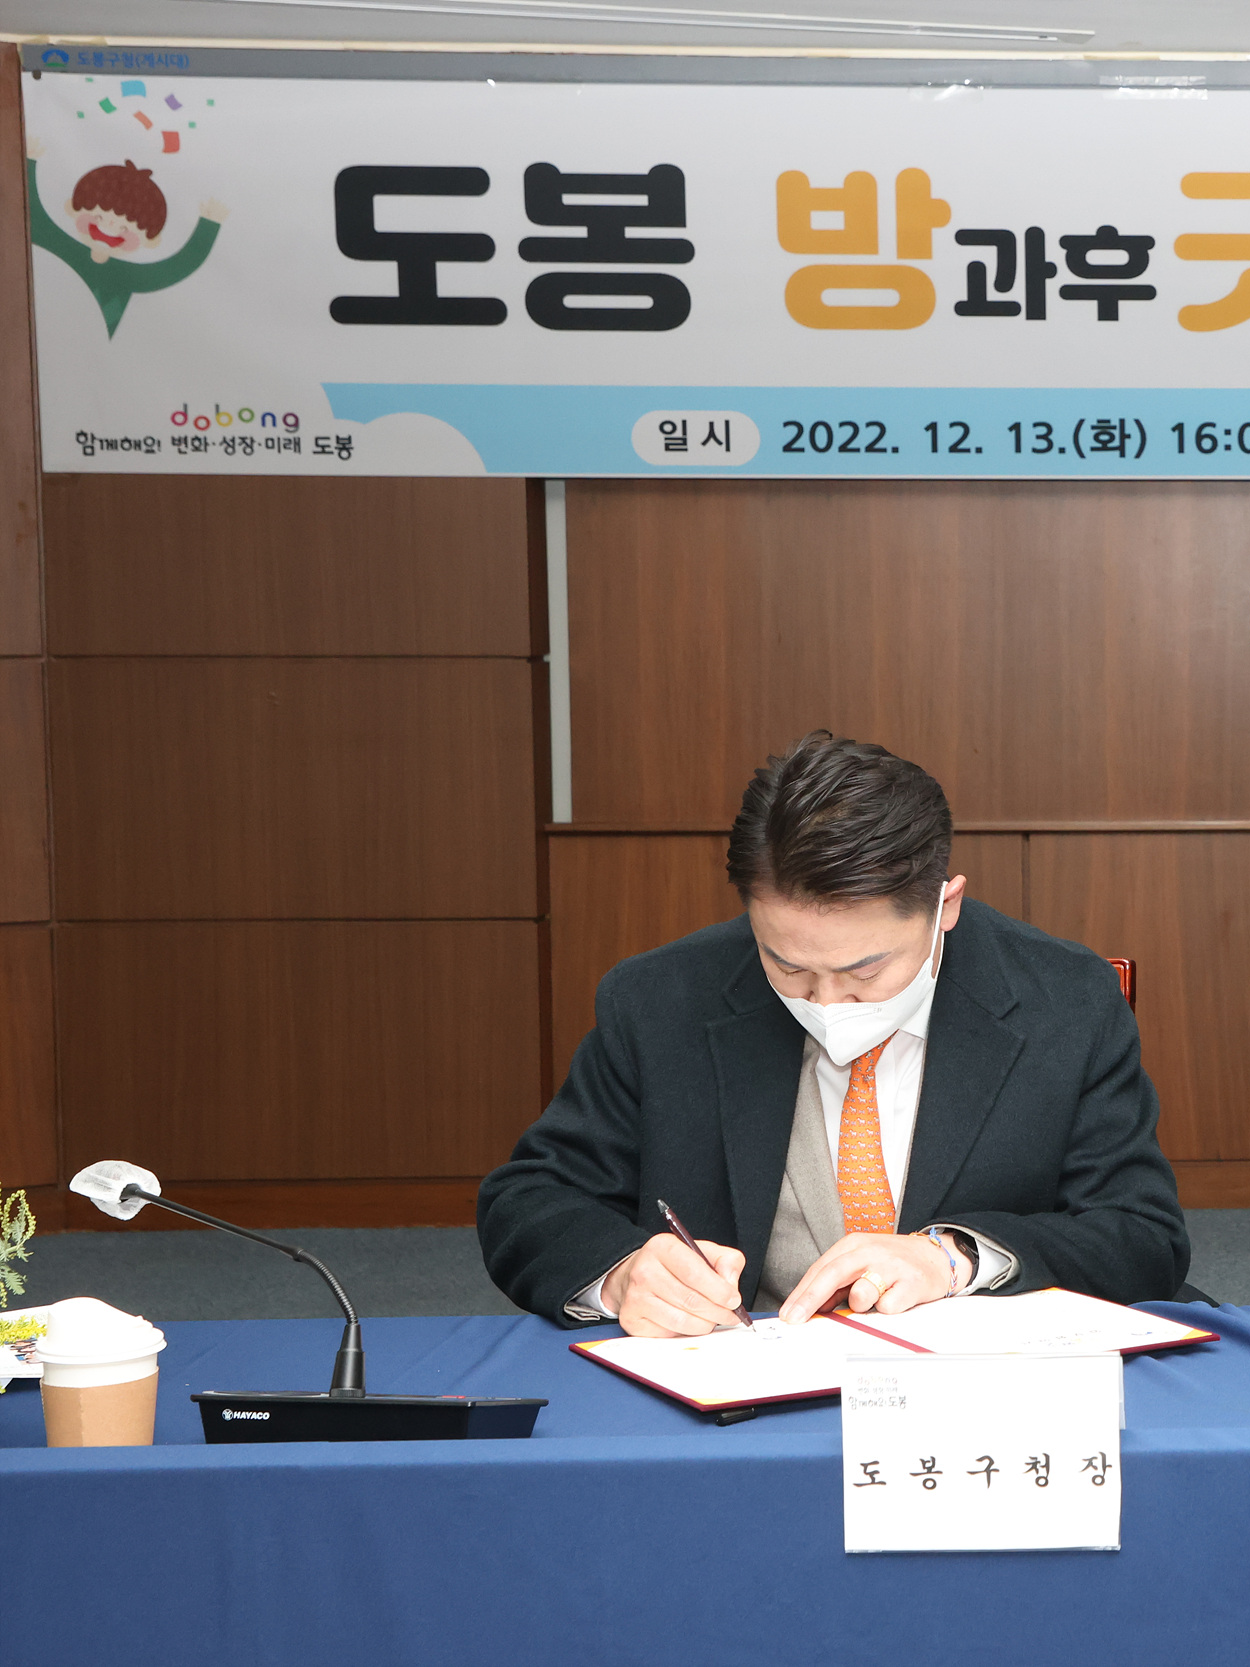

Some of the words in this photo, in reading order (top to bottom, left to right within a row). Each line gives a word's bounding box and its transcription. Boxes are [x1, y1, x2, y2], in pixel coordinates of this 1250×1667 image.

[329, 162, 695, 332] 도봉
[170, 403, 300, 433] dobong
[312, 434, 354, 461] 도봉
[781, 420, 900, 454] 2022.
[923, 421, 983, 454] 12.
[1007, 418, 1148, 459] 13.(화)
[233, 1411, 270, 1420] HAYACO
